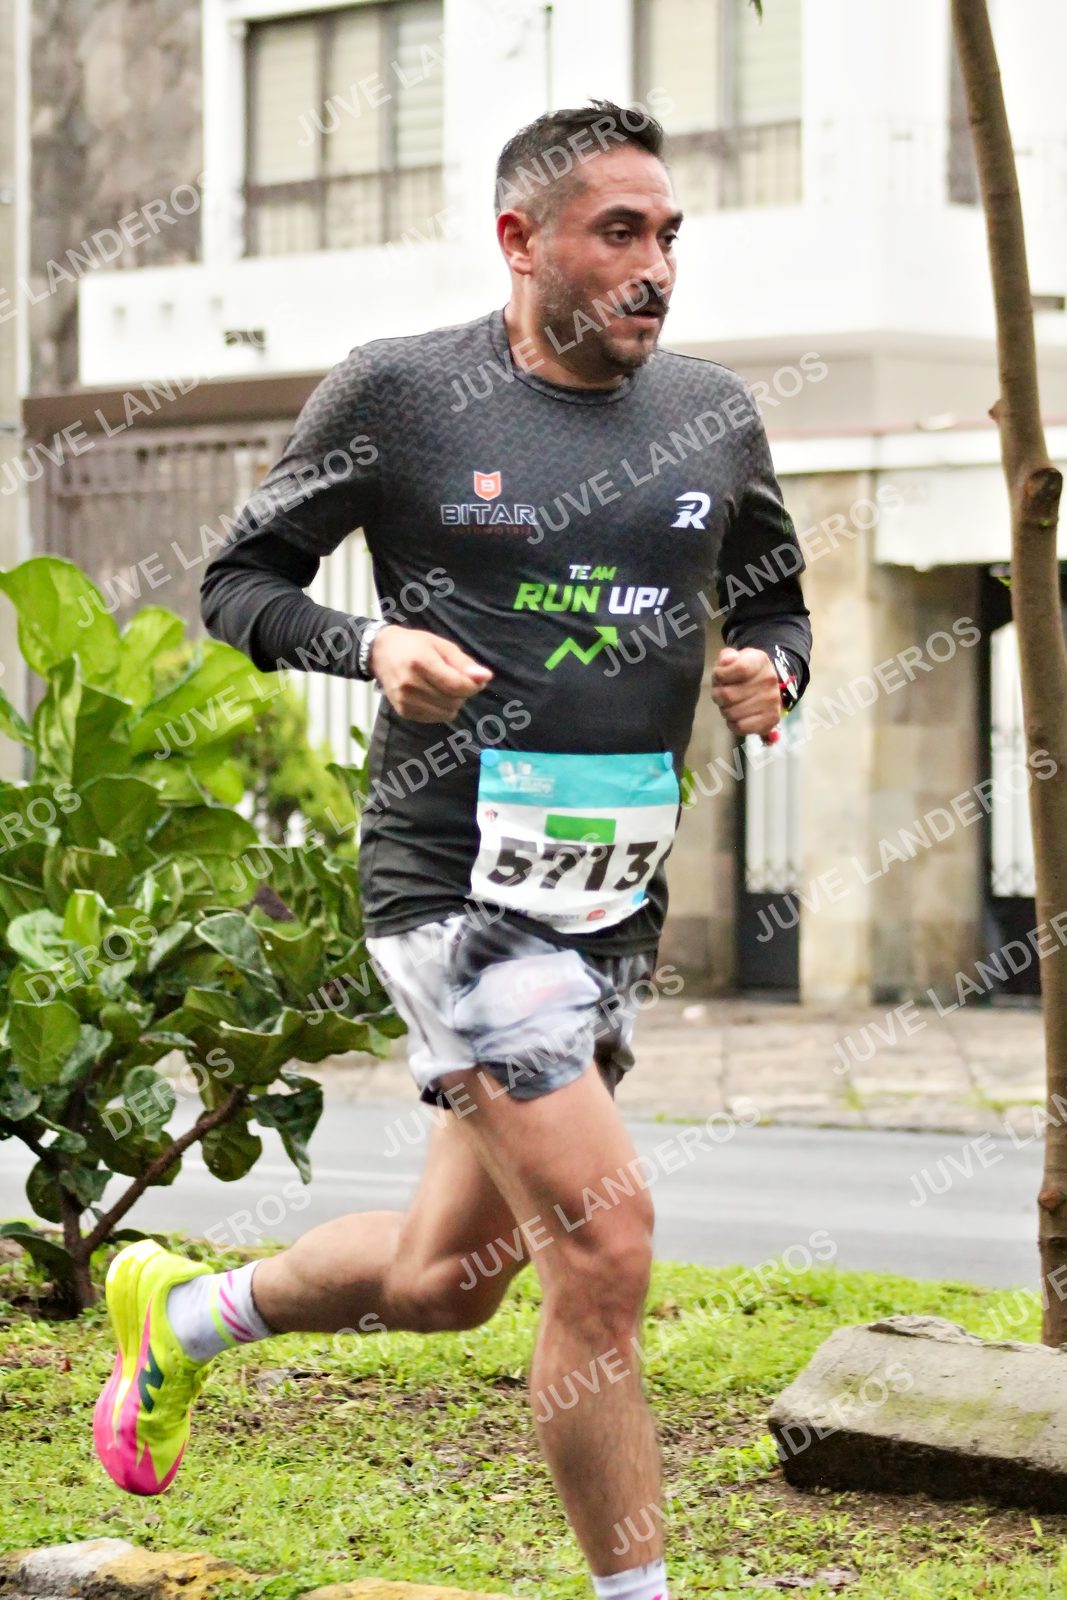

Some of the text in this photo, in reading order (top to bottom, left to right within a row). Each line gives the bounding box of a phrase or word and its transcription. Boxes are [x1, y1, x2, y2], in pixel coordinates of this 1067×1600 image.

[440, 503, 539, 525] BITAR
[569, 564, 617, 581] TEAM
[513, 582, 670, 616] RUN UP!
[487, 836, 658, 891] 5713
